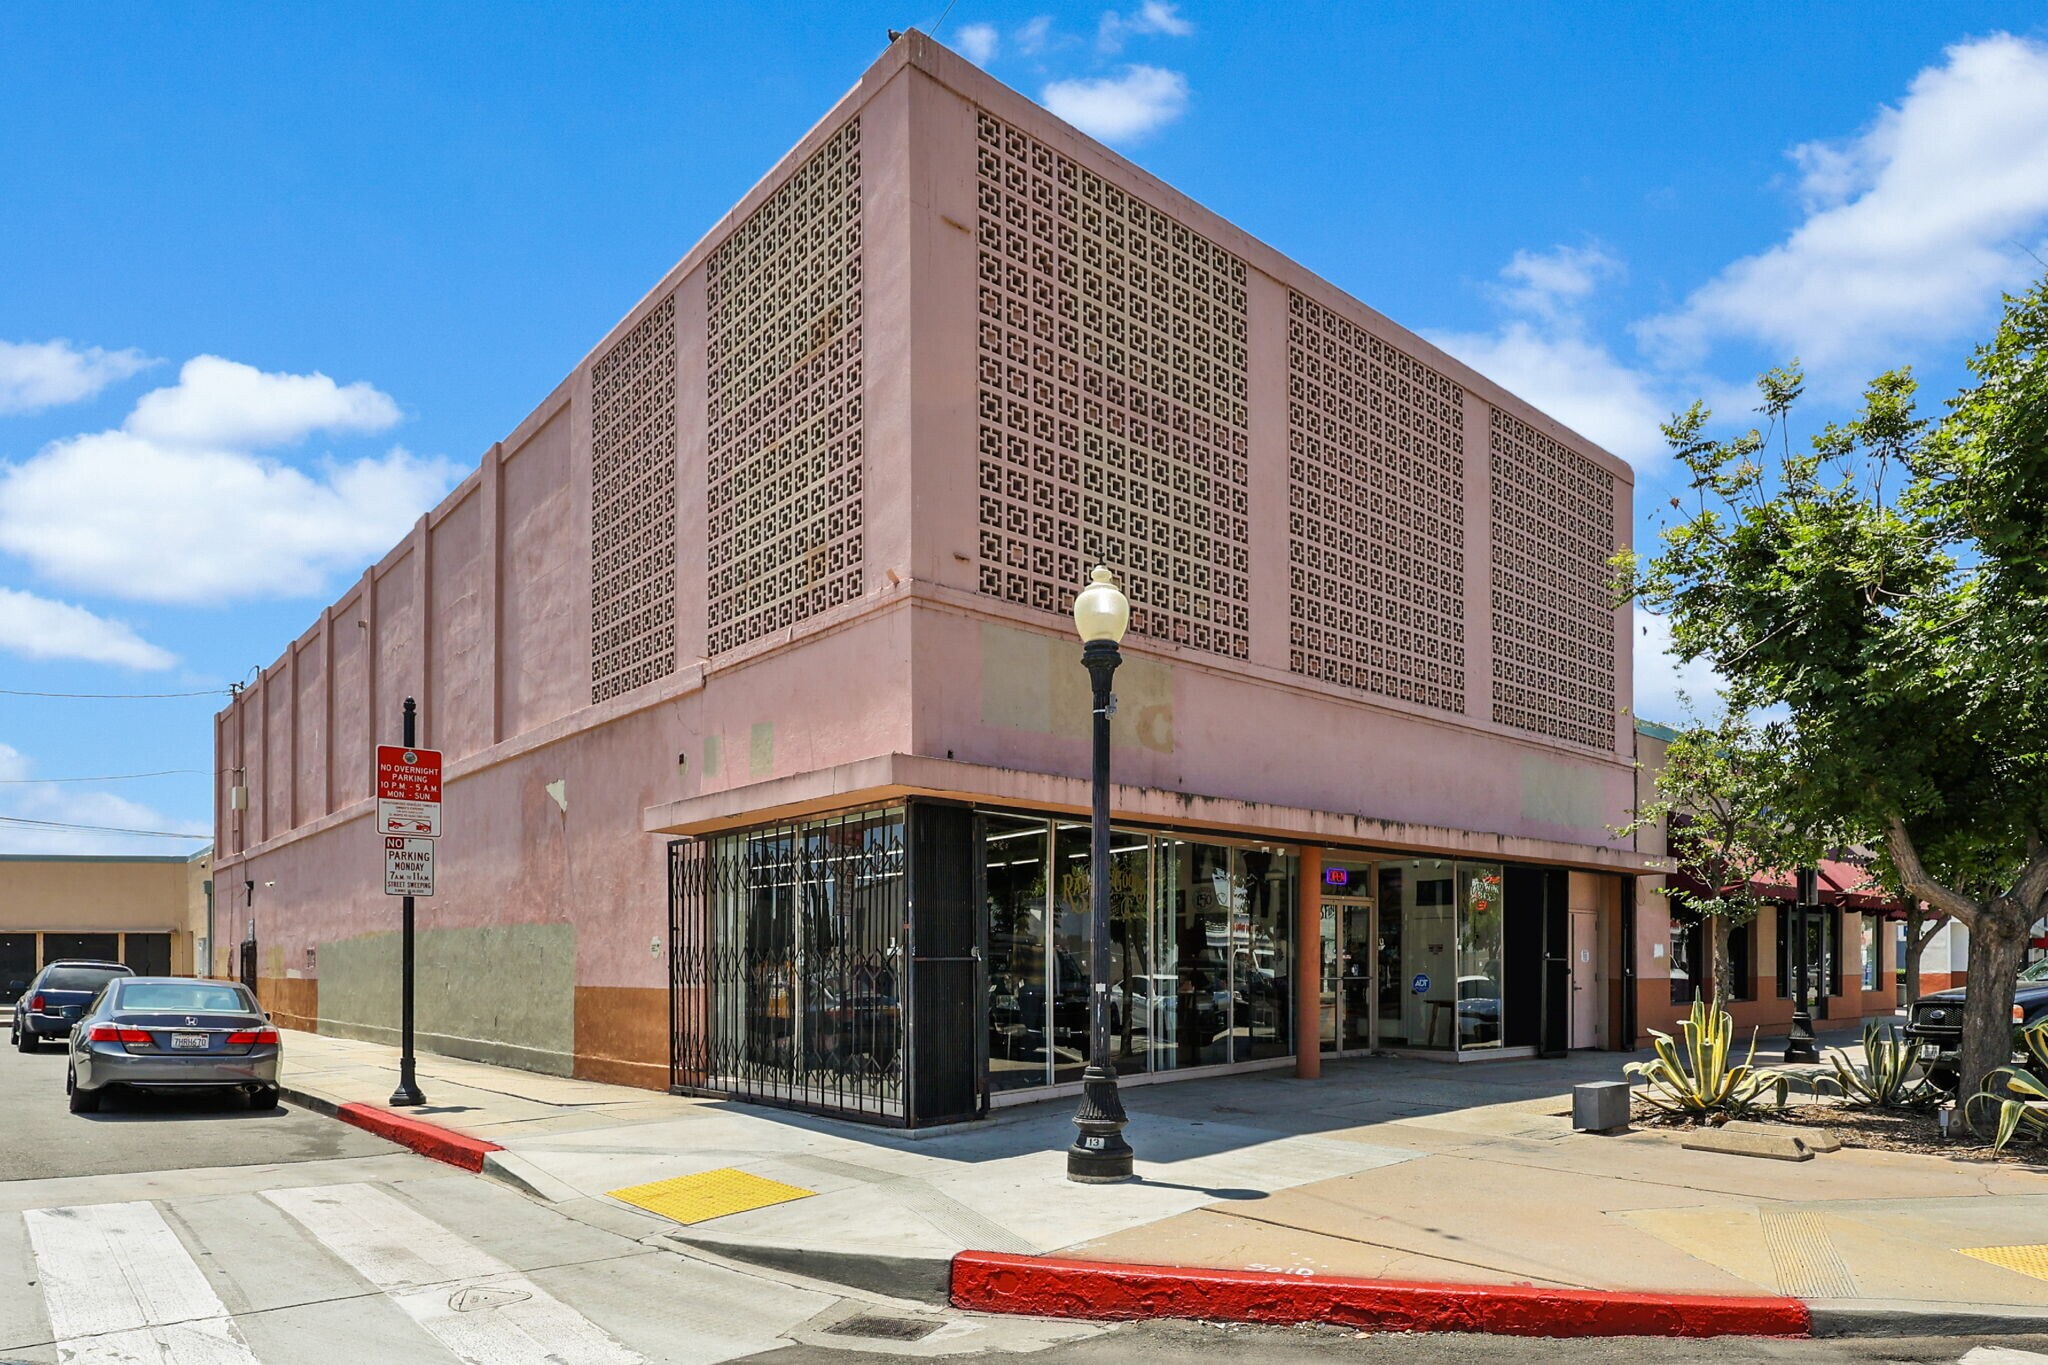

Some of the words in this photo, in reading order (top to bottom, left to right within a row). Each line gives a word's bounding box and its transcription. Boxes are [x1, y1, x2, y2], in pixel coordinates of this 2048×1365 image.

[394, 765, 439, 775] OVERNIGHT
[392, 773, 428, 783] PARKING
[387, 838, 403, 848] NO
[388, 851, 430, 861] PARKING
[394, 861, 425, 871] MONDAY
[1415, 979, 1428, 987] ADT
[1090, 1138, 1099, 1147] 13
